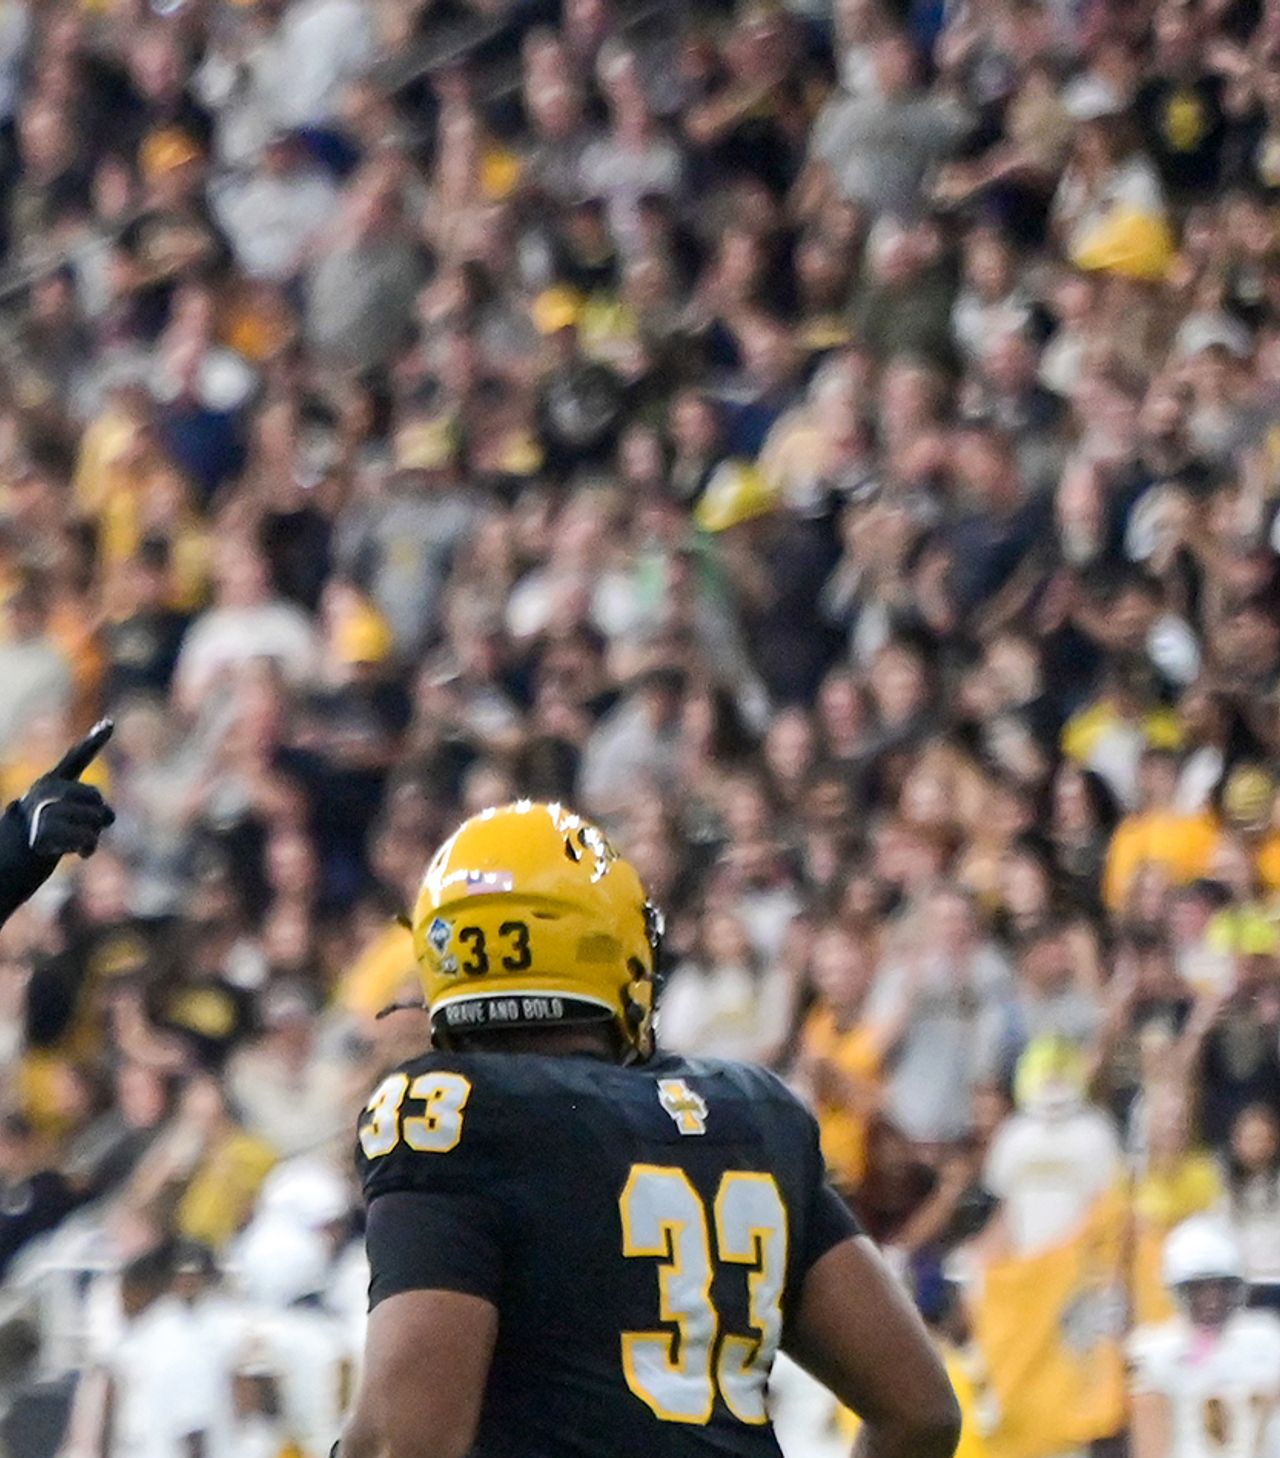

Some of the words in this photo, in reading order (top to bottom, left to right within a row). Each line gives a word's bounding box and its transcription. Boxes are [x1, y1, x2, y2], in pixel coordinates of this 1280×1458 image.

[459, 921, 532, 976] 33
[446, 1000, 485, 1025] BRAVE
[490, 998, 519, 1021] AND
[523, 998, 564, 1020] BOLD
[359, 1070, 473, 1160] 33
[619, 1163, 788, 1426] 33
